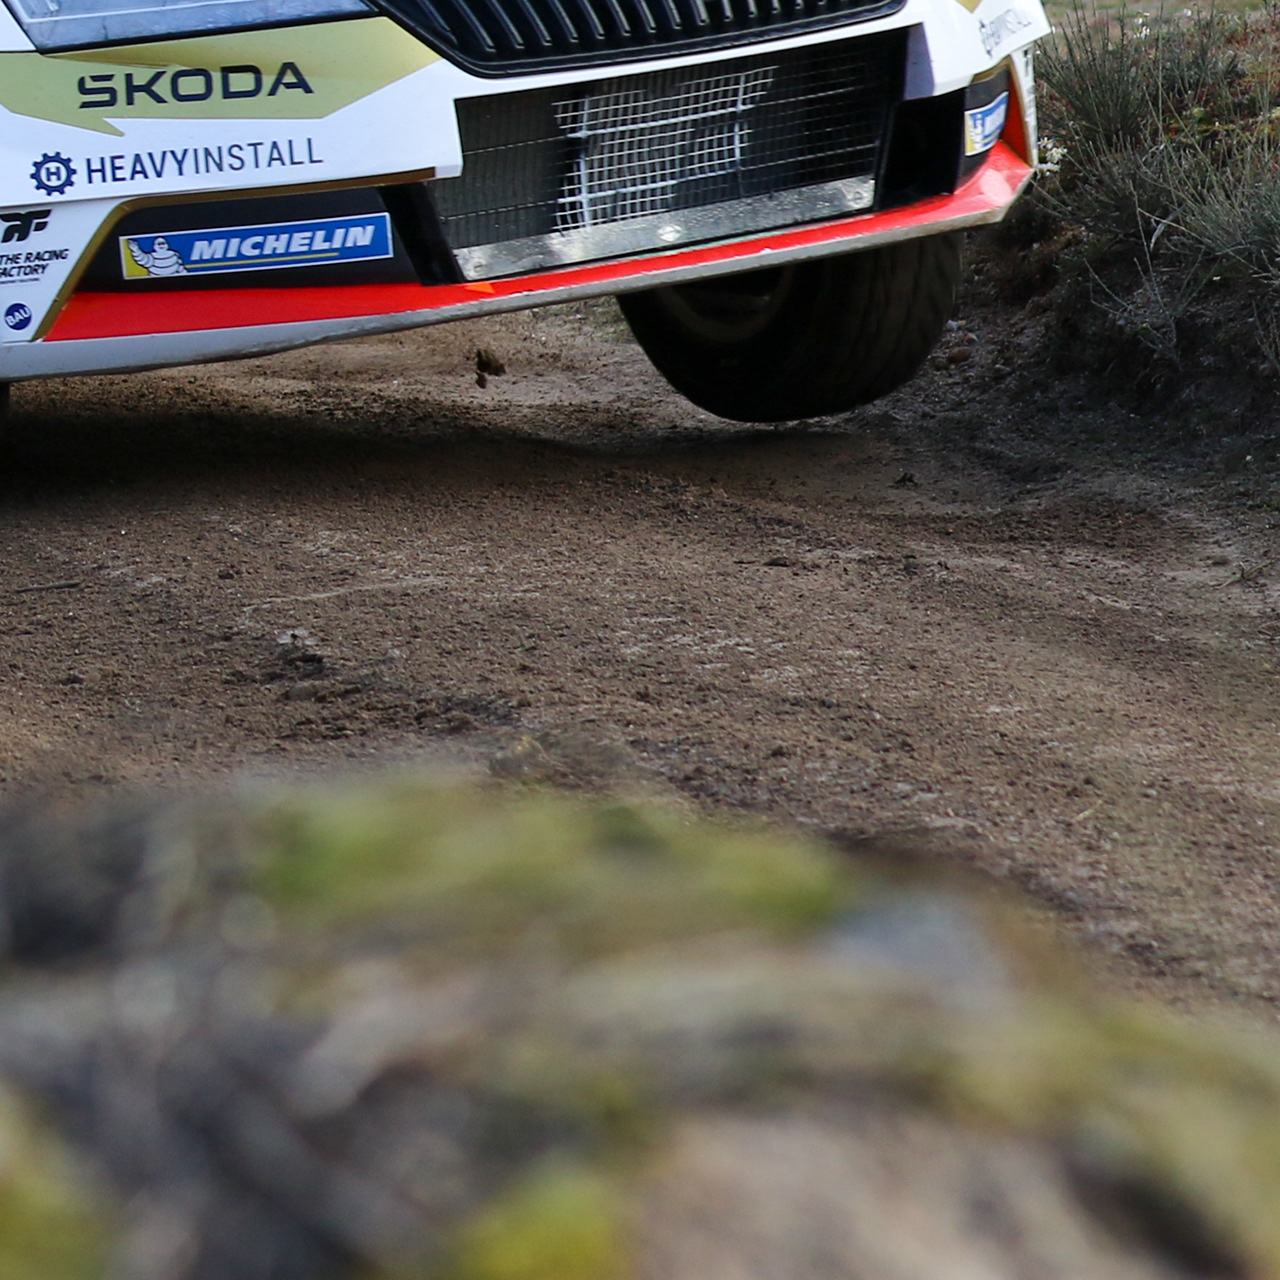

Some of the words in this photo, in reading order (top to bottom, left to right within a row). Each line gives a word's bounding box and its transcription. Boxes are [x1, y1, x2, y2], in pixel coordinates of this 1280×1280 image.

[86, 137, 324, 186] HEAVYINSTALL
[0, 252, 23, 266] THE
[25, 248, 70, 264] RACING
[189, 224, 375, 261] MICHELIN
[5, 306, 31, 327] BAU
